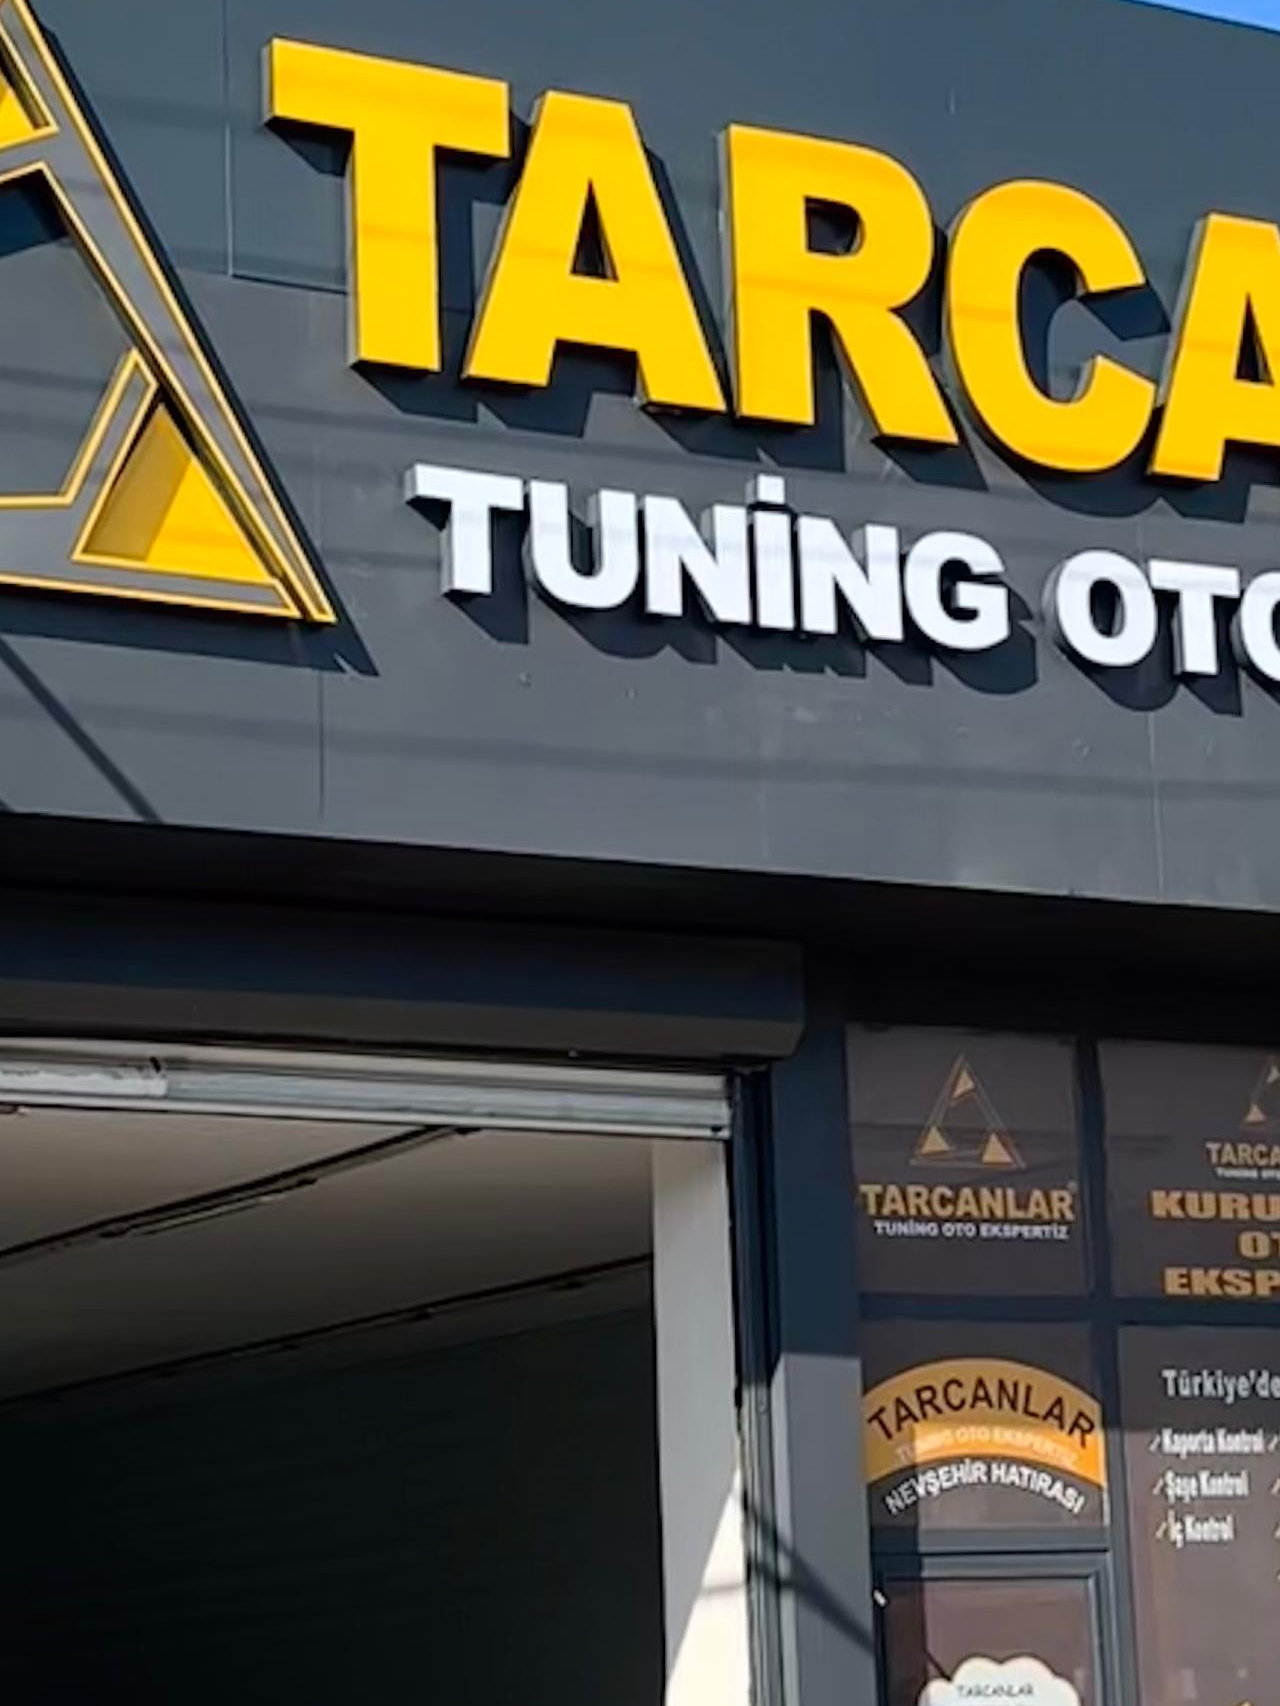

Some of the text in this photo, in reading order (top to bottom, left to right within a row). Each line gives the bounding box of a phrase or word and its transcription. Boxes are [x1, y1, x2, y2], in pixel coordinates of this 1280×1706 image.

[404, 461, 1012, 655] TUNİNG
[858, 1183, 1076, 1222] TARCANLAR
[941, 1222, 978, 1238] OTO
[867, 1376, 1096, 1449] TARCANLAR
[885, 1458, 1086, 1515] NEVŞEHİR HATIRASI
